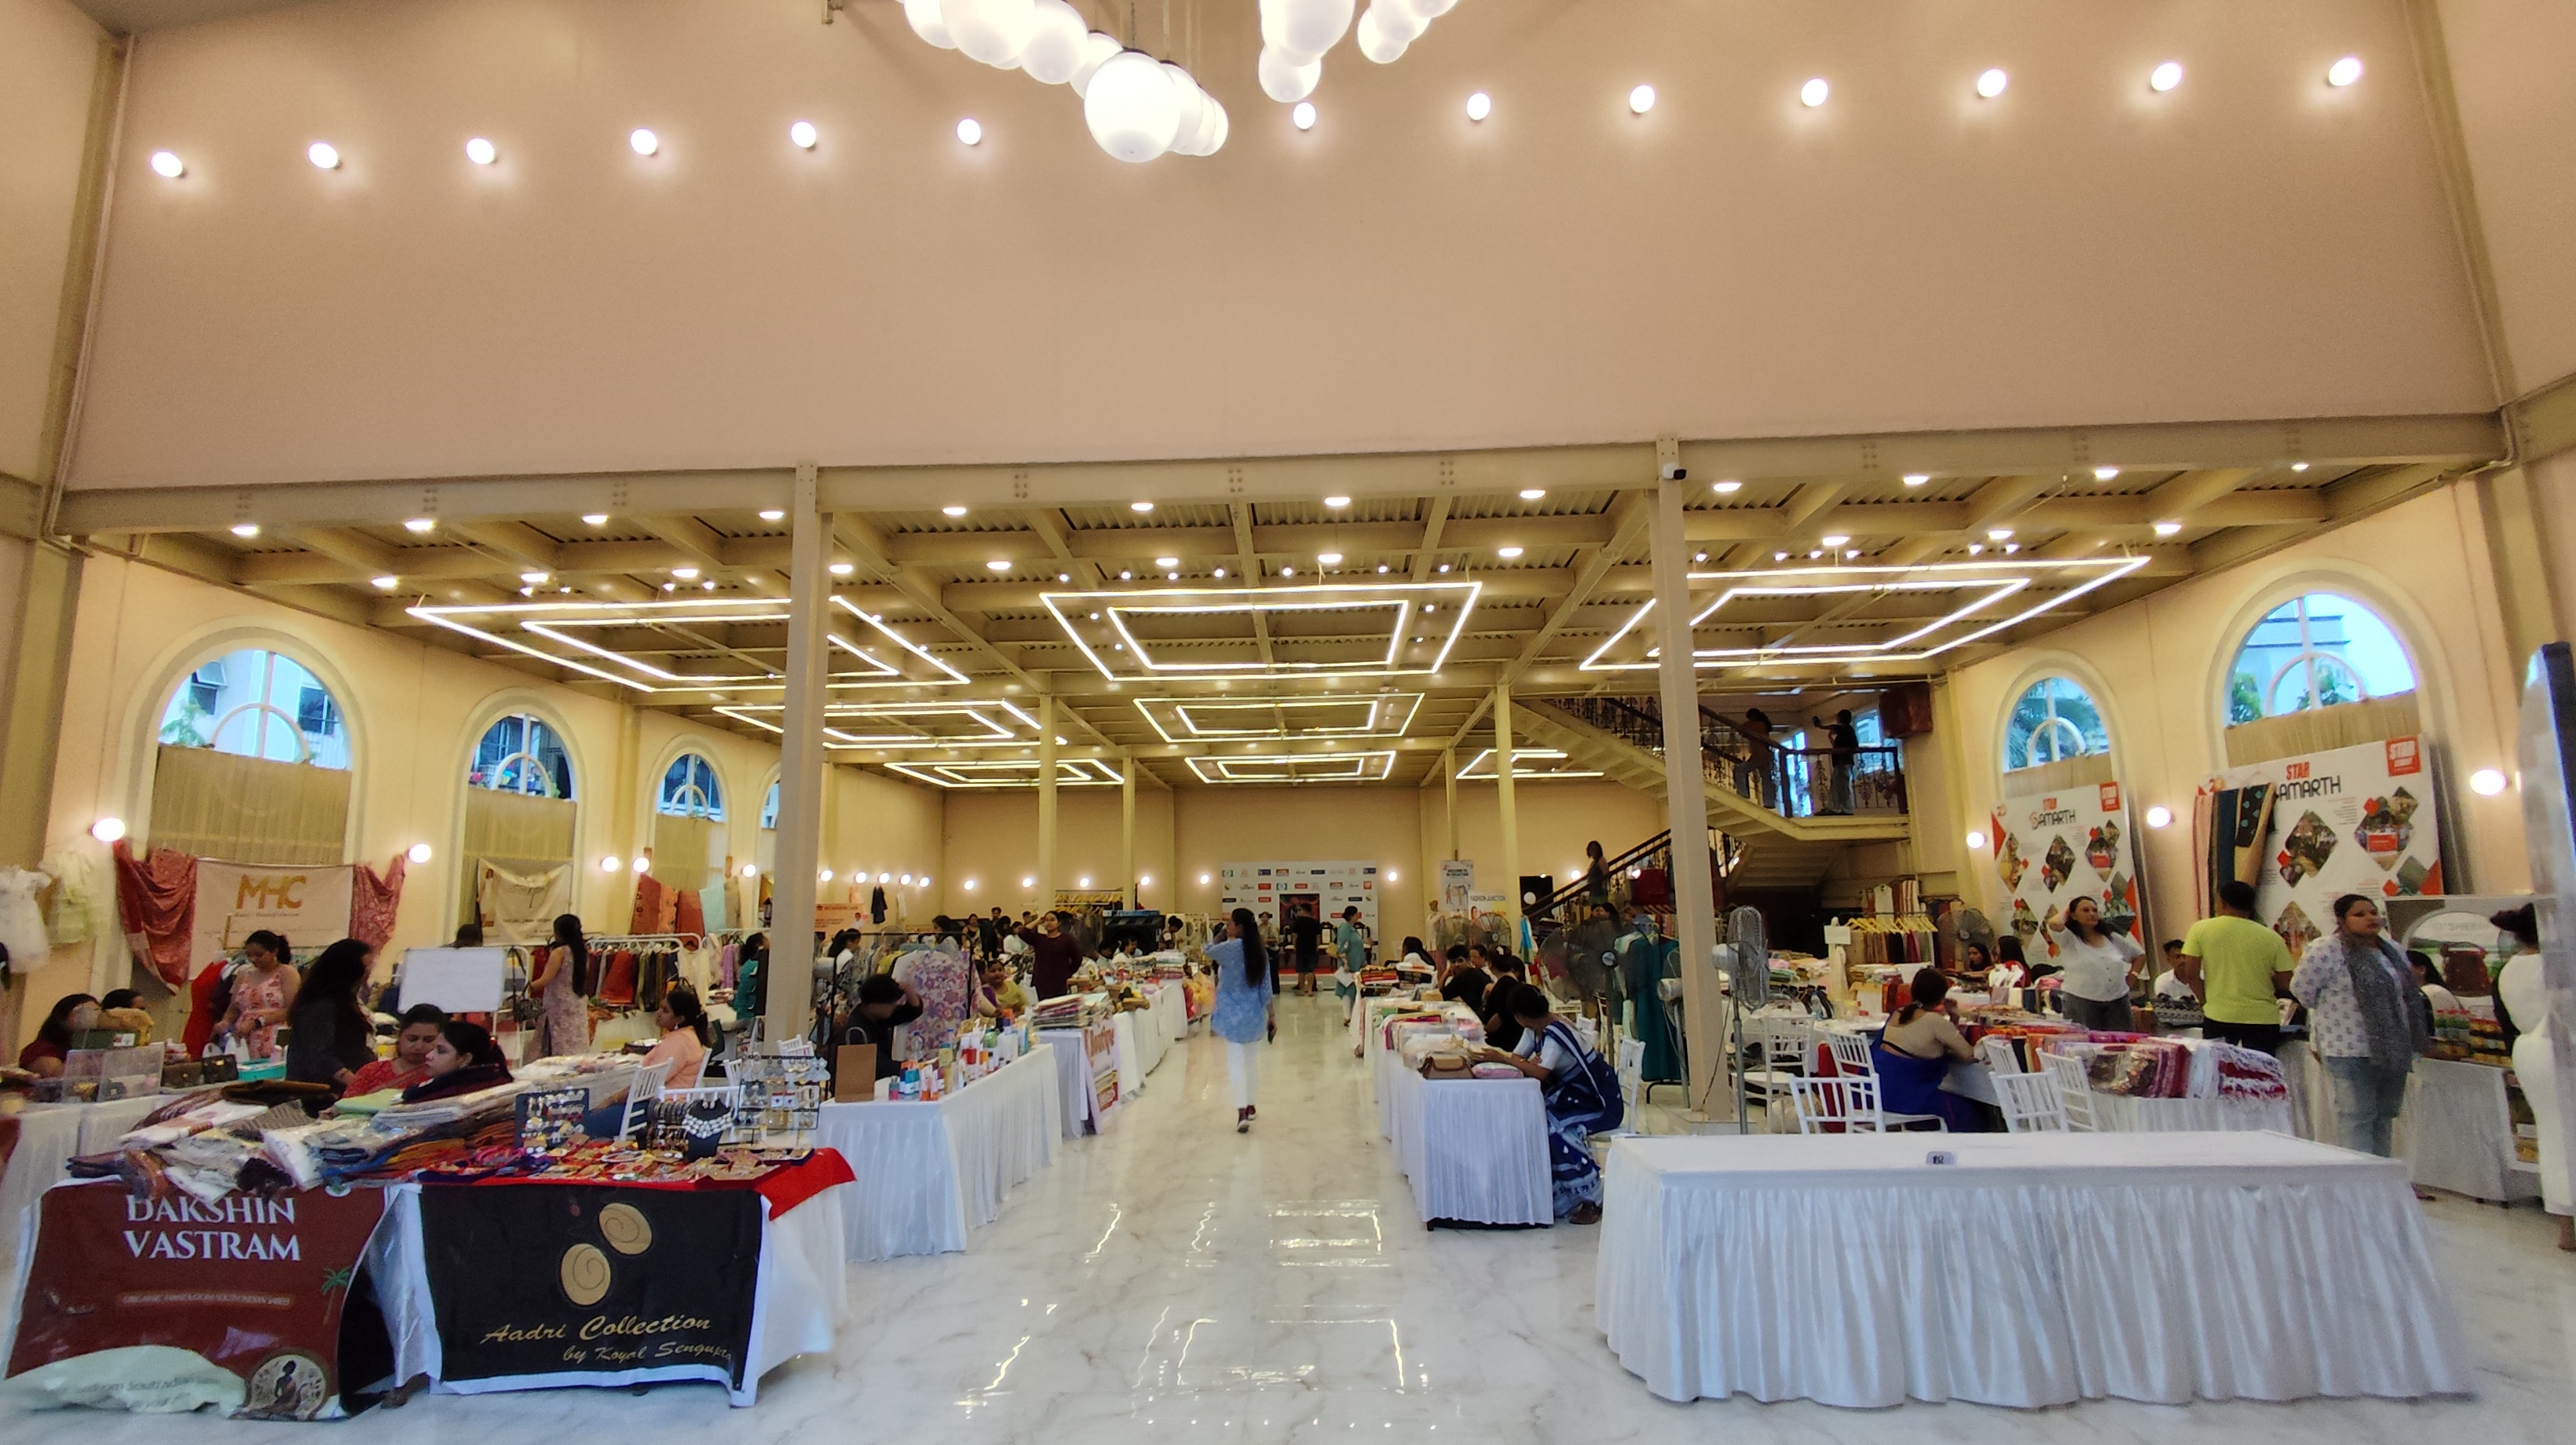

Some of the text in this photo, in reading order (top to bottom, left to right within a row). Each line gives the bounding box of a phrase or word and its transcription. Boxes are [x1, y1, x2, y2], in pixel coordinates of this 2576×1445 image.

[2286, 762, 2310, 780] STAR
[2277, 775, 2342, 801] AMARTH
[2029, 809, 2076, 829] SAMARTH
[236, 873, 307, 909] MHC
[126, 1194, 295, 1224] DAKSHIN
[123, 1230, 301, 1261] VASTRAM
[479, 1314, 711, 1344] Aadri Collection
[563, 1341, 732, 1364] by Koyal Sengupta
